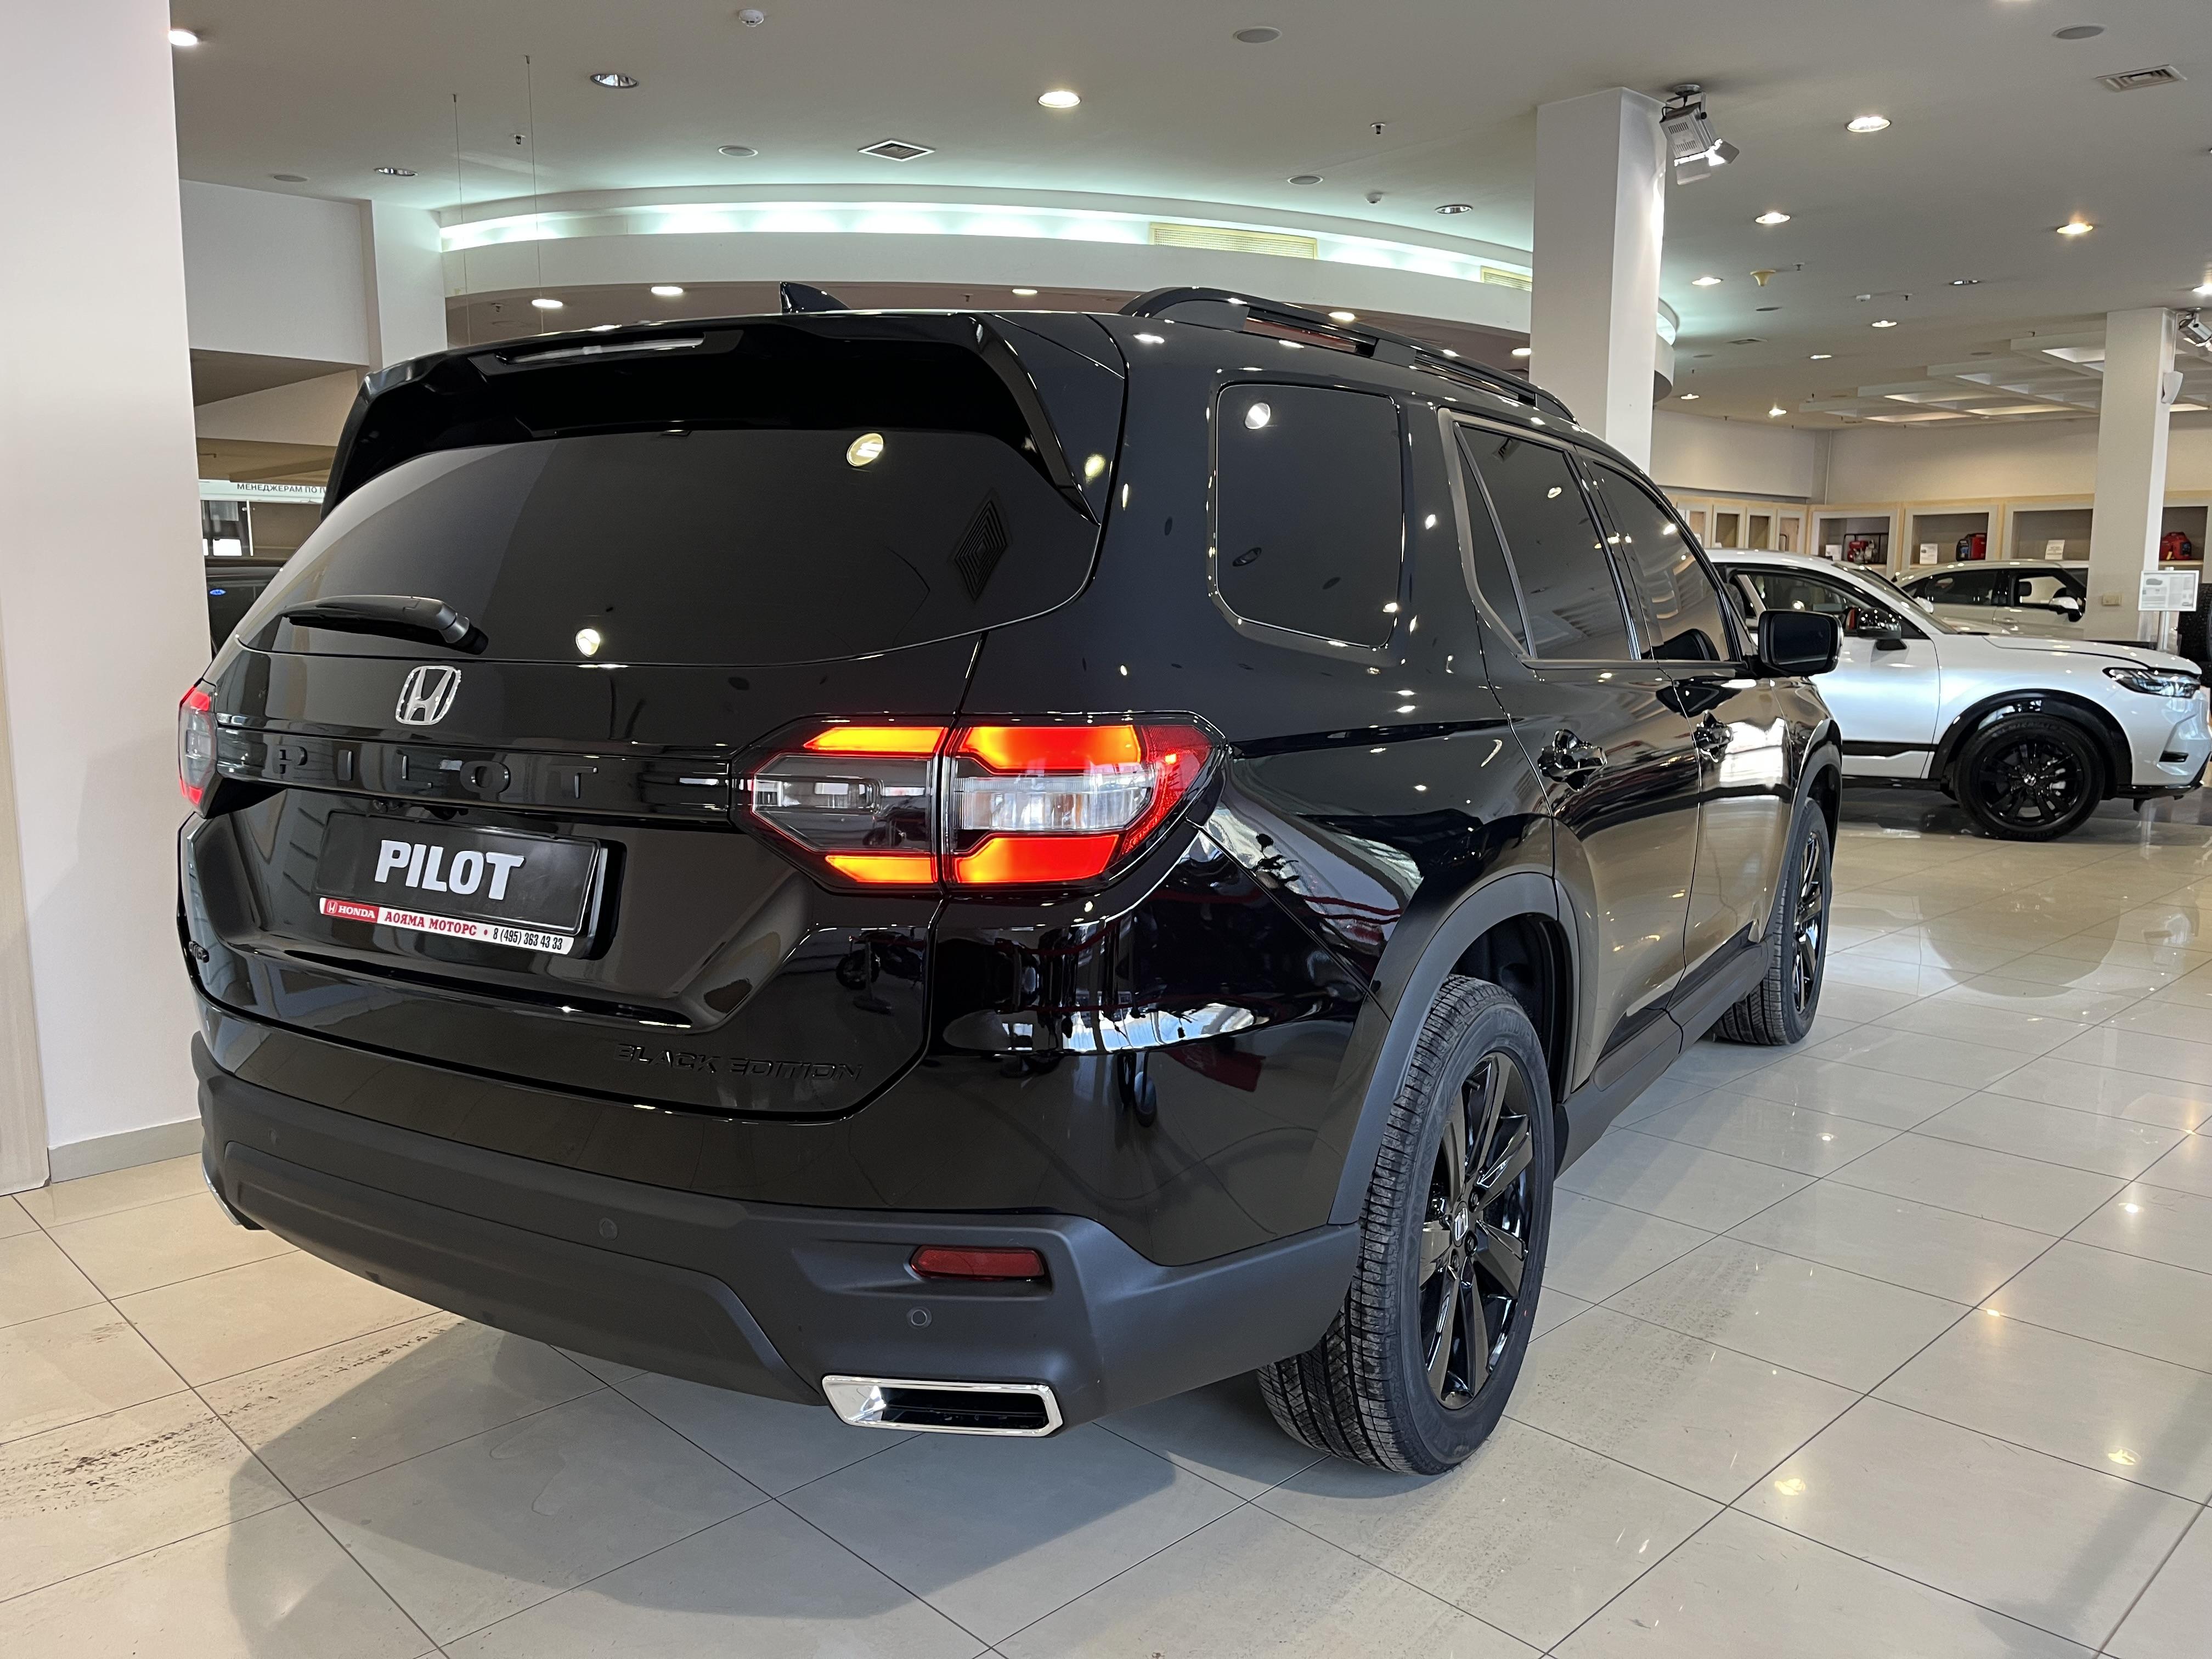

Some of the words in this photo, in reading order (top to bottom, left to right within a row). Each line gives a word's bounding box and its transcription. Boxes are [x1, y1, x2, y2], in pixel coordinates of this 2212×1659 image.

[237, 483, 302, 492] МЕНЕДЖЕРАМ
[273, 745, 598, 799] PILOT
[374, 839, 525, 900] PILOT
[338, 905, 375, 919] HONDA
[384, 911, 425, 928] АОЯМА
[430, 918, 477, 936] МОТОРС
[493, 928, 499, 940] 8
[500, 929, 522, 945] (495)
[524, 932, 539, 946] 363
[540, 935, 551, 948] 43
[552, 937, 562, 950] 33
[615, 1043, 721, 1073] BLACK
[729, 1057, 864, 1081] EDITION
